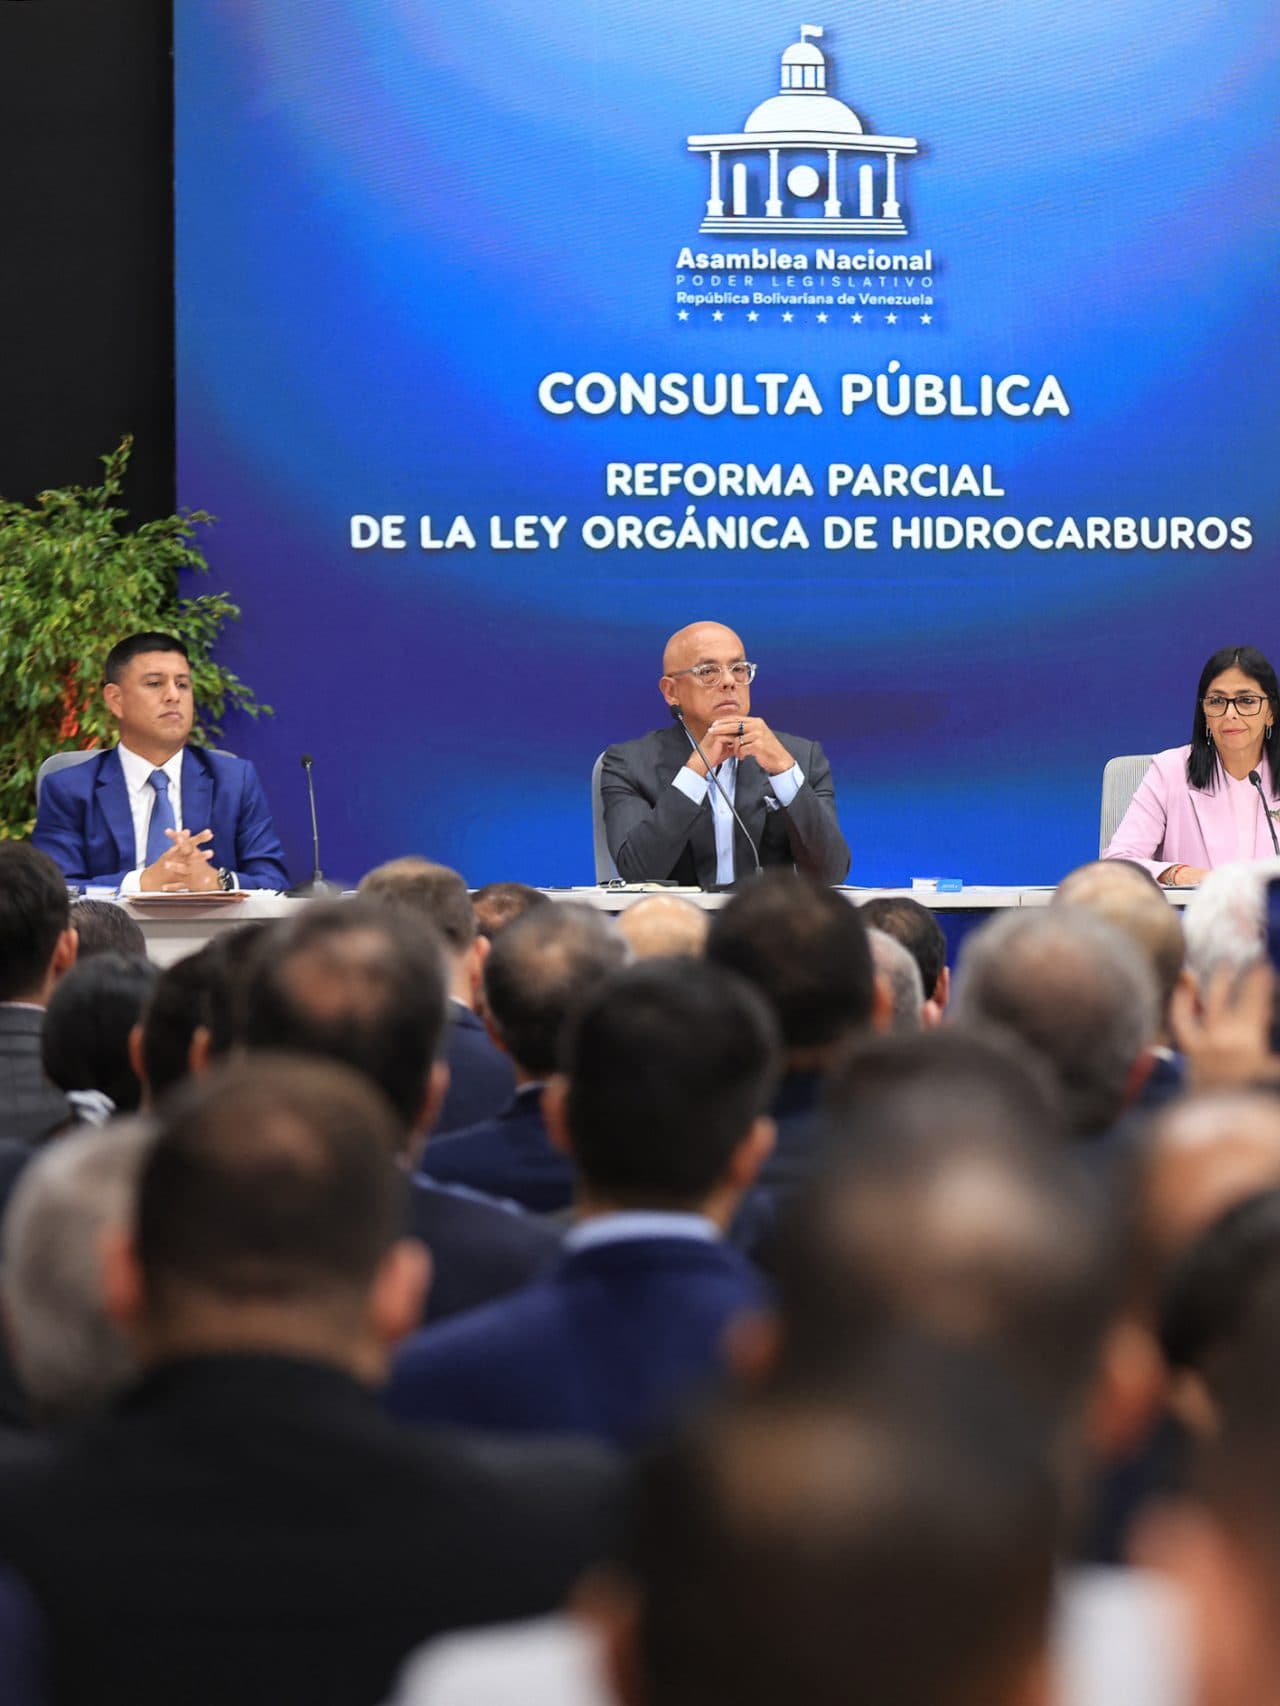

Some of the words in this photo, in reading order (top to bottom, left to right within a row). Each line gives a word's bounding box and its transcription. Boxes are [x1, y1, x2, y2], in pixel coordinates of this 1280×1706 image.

[675, 247, 808, 270] Asamblea
[816, 248, 932, 271] Nacional
[676, 275, 754, 286] PODER
[772, 276, 933, 288] LEGISLATIVO
[676, 291, 750, 306] República
[753, 292, 834, 305] Bolivariana
[837, 292, 856, 304] de
[859, 292, 933, 305] Venezuela
[537, 372, 823, 416] CONSULTA
[841, 359, 1070, 417] PÚBLICA
[606, 462, 814, 498] REFORMA
[827, 463, 1005, 498] PARCIAL
[350, 514, 406, 550] DE
[419, 515, 476, 550] LA
[490, 515, 567, 550] LEY
[581, 505, 810, 550] ORGÁNICA
[824, 516, 878, 550] DE
[891, 515, 1253, 551] HIDROCARBUROS
